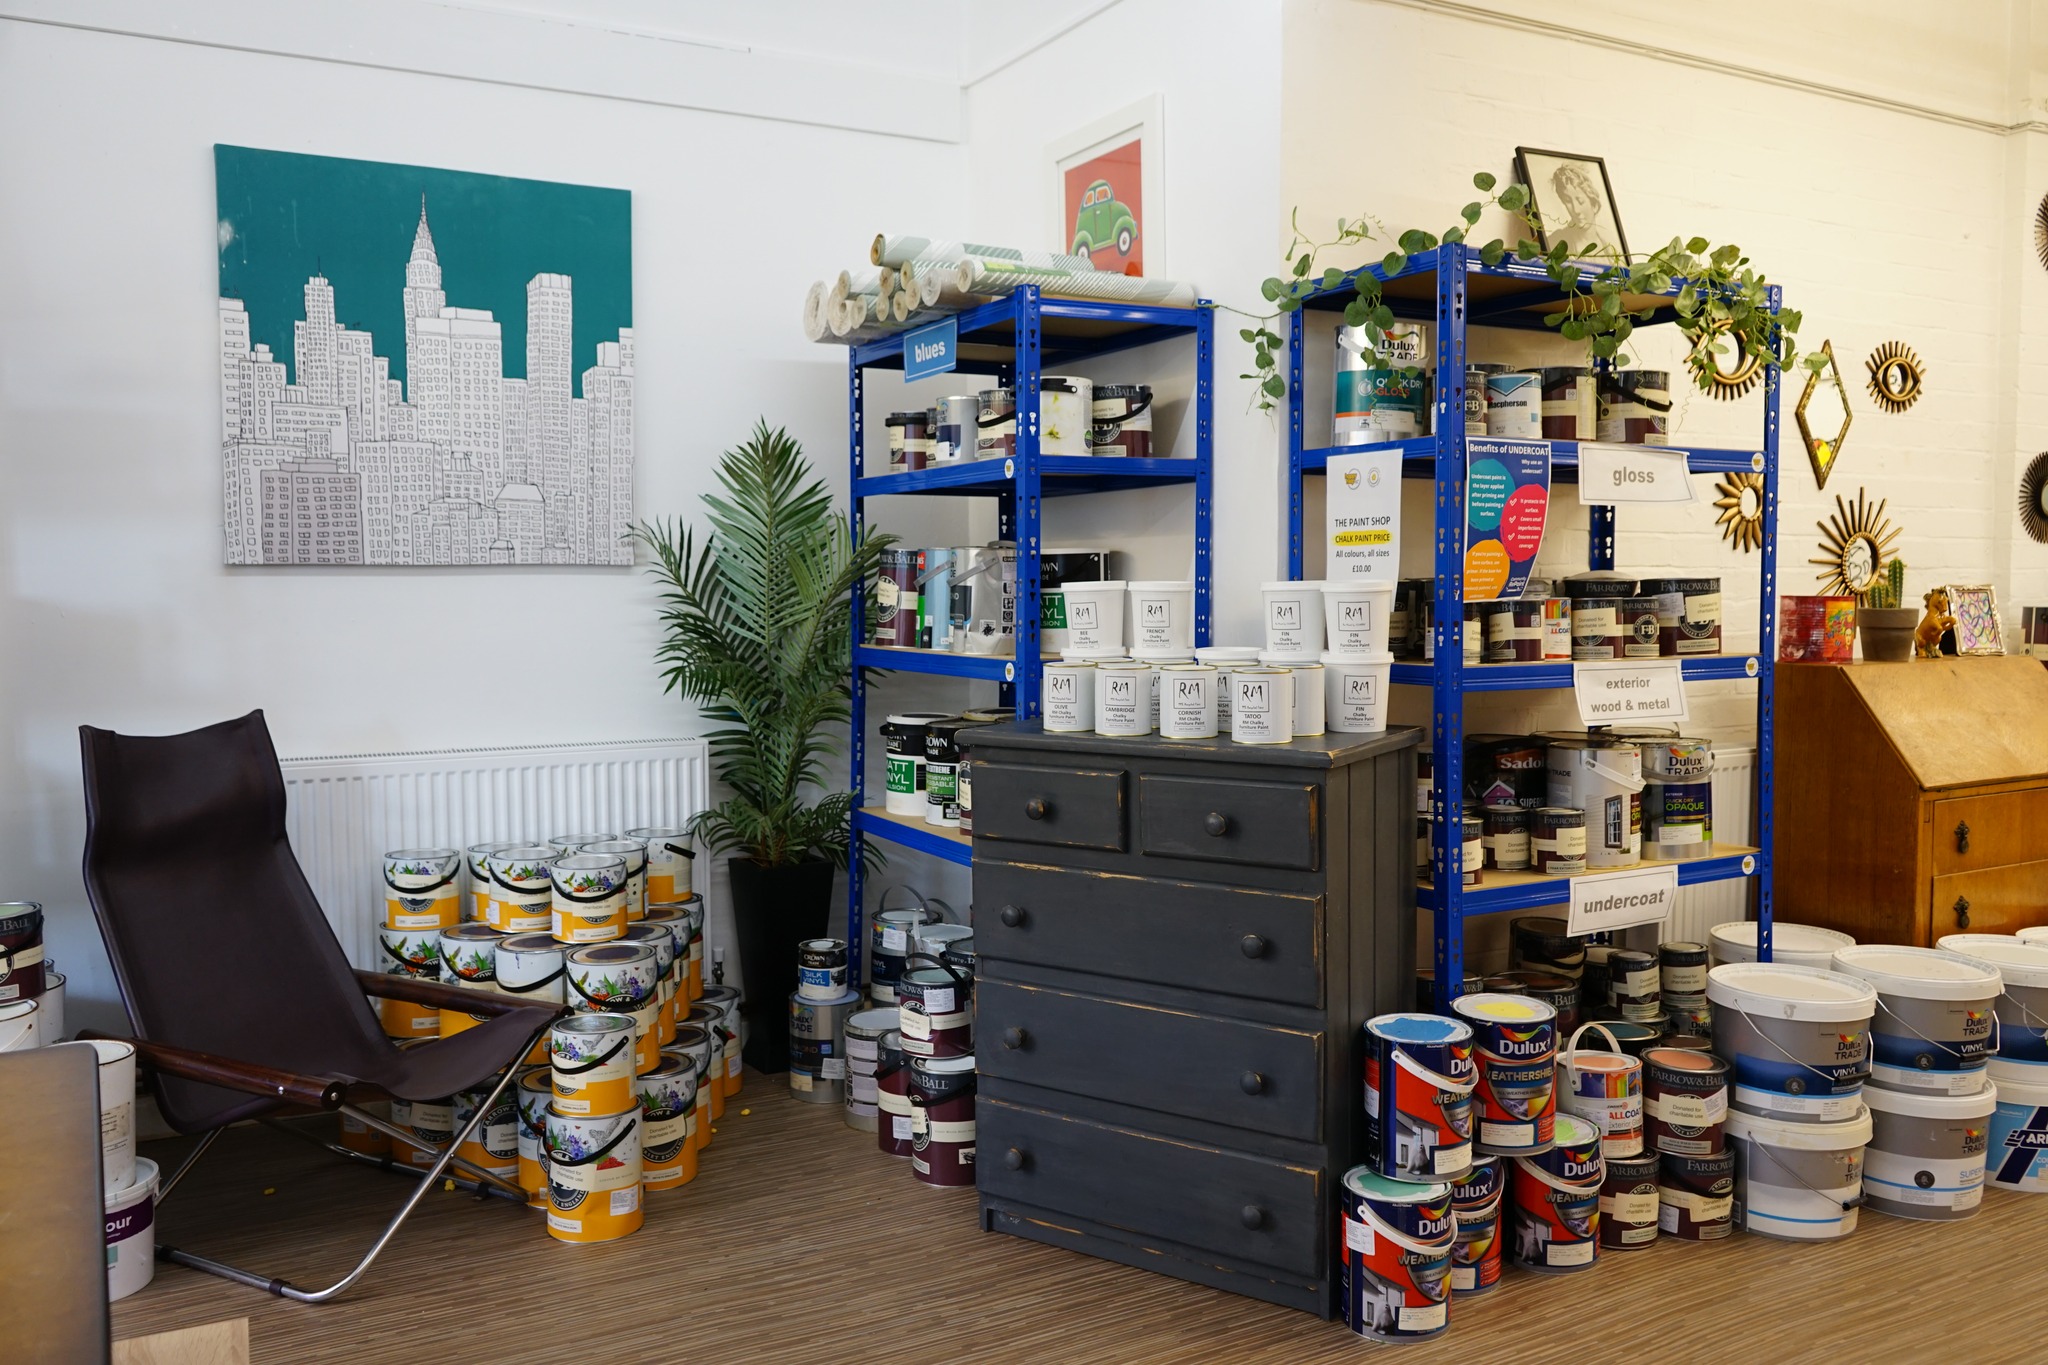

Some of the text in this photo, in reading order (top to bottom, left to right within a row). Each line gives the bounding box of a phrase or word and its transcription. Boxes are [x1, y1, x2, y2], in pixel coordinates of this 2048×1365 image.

[1382, 340, 1416, 350] Dulux
[914, 341, 946, 363] blues
[1410, 380, 1423, 388] DRY
[1376, 388, 1410, 396] GLOSS
[1488, 400, 1528, 408] Macpherson
[1470, 444, 1549, 455] Benefits of UNDERCOAT
[1612, 466, 1655, 487] gloss
[1335, 516, 1391, 527] THE PAINT SHOP
[1335, 533, 1390, 543] CHALK PAINT PRICE
[1344, 549, 1366, 558] colours,
[1376, 549, 1389, 557] sizes
[1352, 564, 1372, 573] £10.00
[1076, 607, 1090, 620] RM
[1147, 604, 1163, 619] RM
[1276, 606, 1293, 619] RM
[1345, 607, 1362, 620] RM
[1051, 676, 1071, 694] RM
[1111, 681, 1129, 695] RM
[1351, 680, 1369, 694] RM
[1606, 676, 1650, 690] exterior
[1178, 681, 1201, 699] RM
[1242, 684, 1263, 702] RM
[1591, 698, 1670, 713] wood & metal
[888, 761, 908, 772] ATT
[1669, 757, 1702, 767] Dulux
[1552, 769, 1571, 777] TRADE
[1665, 767, 1704, 776] TRADE
[888, 773, 909, 784] NYL
[1666, 802, 1704, 811] OPAQUE
[1584, 888, 1665, 914] undercoat
[804, 954, 825, 962] CROWN
[804, 970, 822, 978] SILK
[1966, 1018, 1987, 1028] Dulux
[1963, 1026, 1988, 1036] TRADE
[1500, 1039, 1546, 1055] Dulux
[1961, 1043, 1984, 1053] VINYL
[1835, 1049, 1862, 1060] TRADE
[1484, 1067, 1553, 1082] WEATHERSHIEL
[1833, 1067, 1857, 1077] VINYL
[922, 1076, 949, 1090] BALL
[1673, 1104, 1694, 1112] Donated
[485, 1106, 510, 1126] ARROW
[1669, 1110, 1693, 1119] charitable
[650, 1125, 668, 1134] Donated
[1962, 1143, 1986, 1154] TRADE
[1564, 1161, 1600, 1176] Dulux
[1454, 1183, 1491, 1198] ulux
[1419, 1216, 1450, 1236] Dulu
